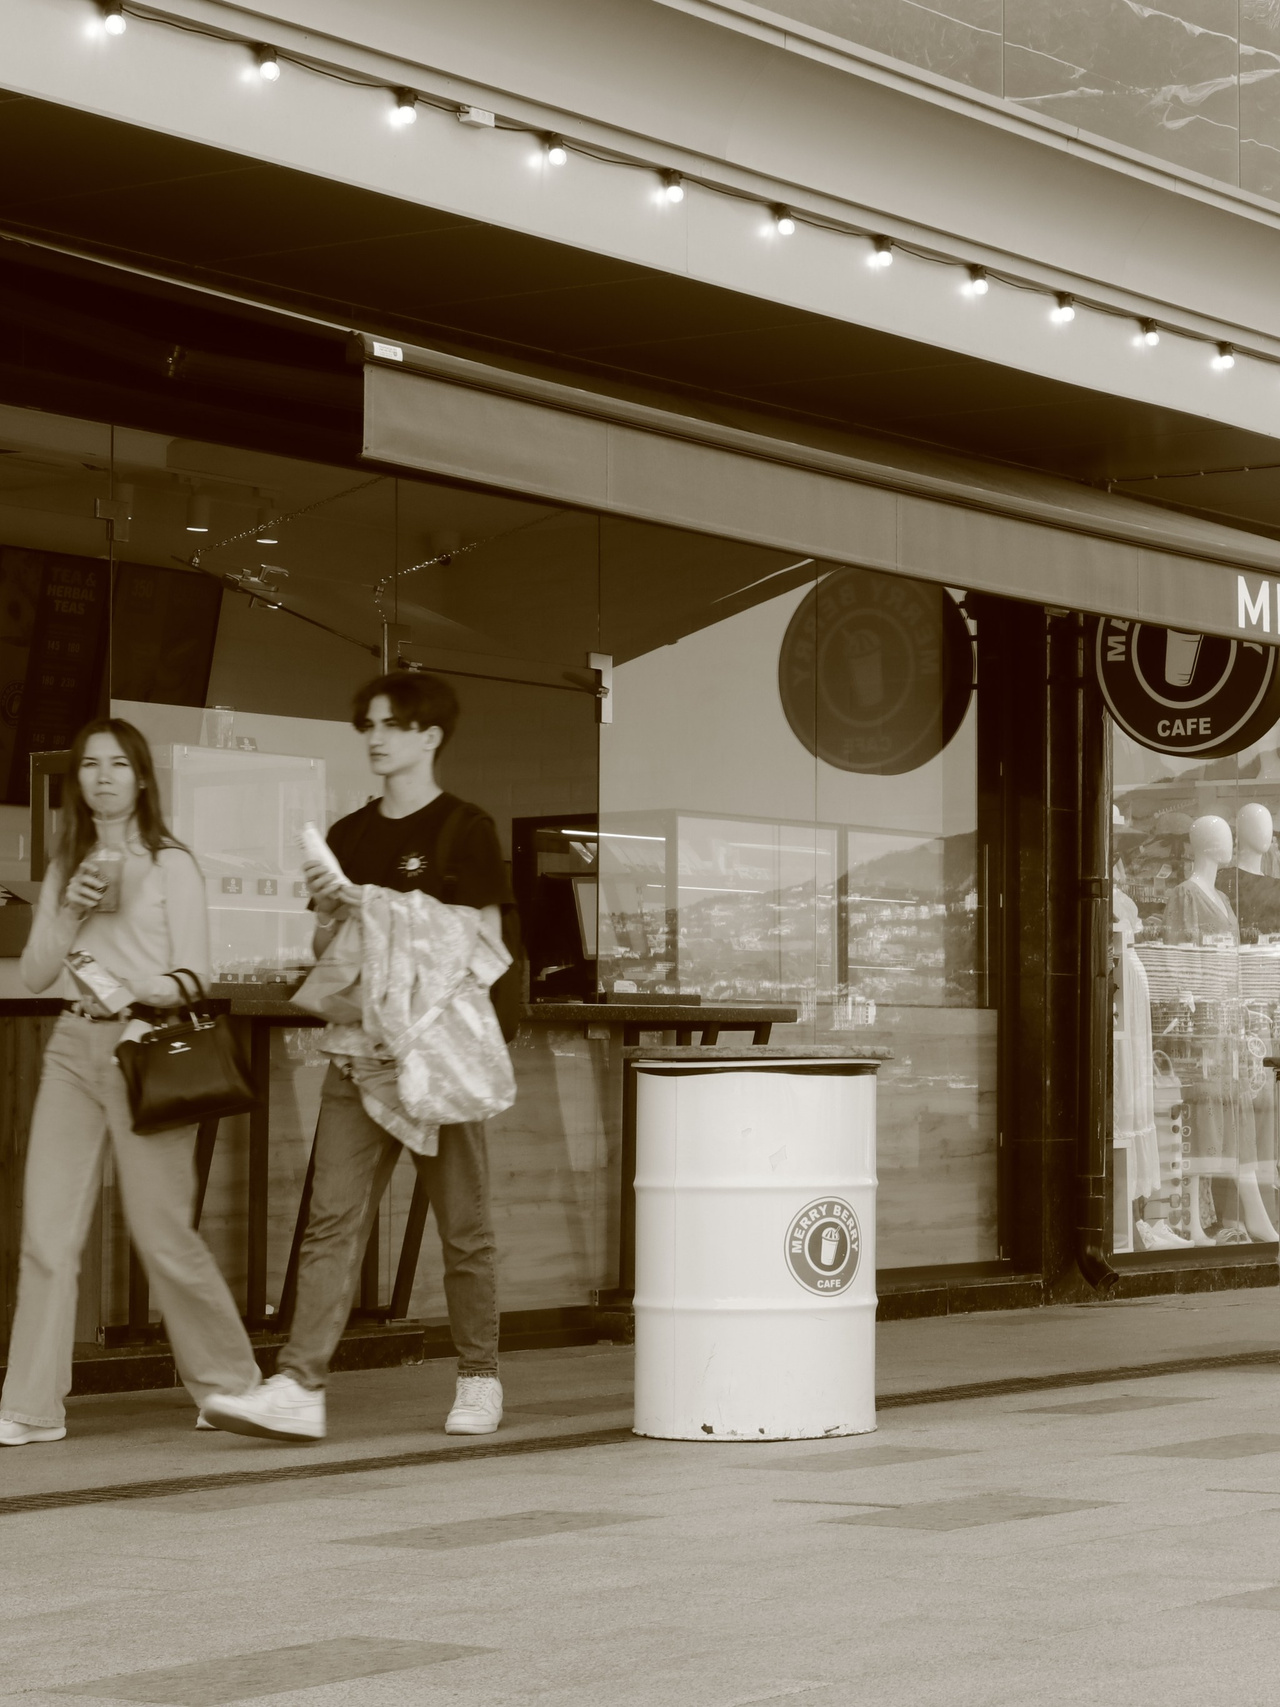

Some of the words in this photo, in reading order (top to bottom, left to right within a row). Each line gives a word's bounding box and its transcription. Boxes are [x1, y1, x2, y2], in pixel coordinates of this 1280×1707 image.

[47, 584, 96, 602] HERBAL
[53, 599, 86, 616] TEAS
[1156, 716, 1212, 738] CAFE
[791, 1204, 828, 1254] MERRY
[833, 1204, 859, 1252] BERRY
[817, 1279, 841, 1288] CAFE
